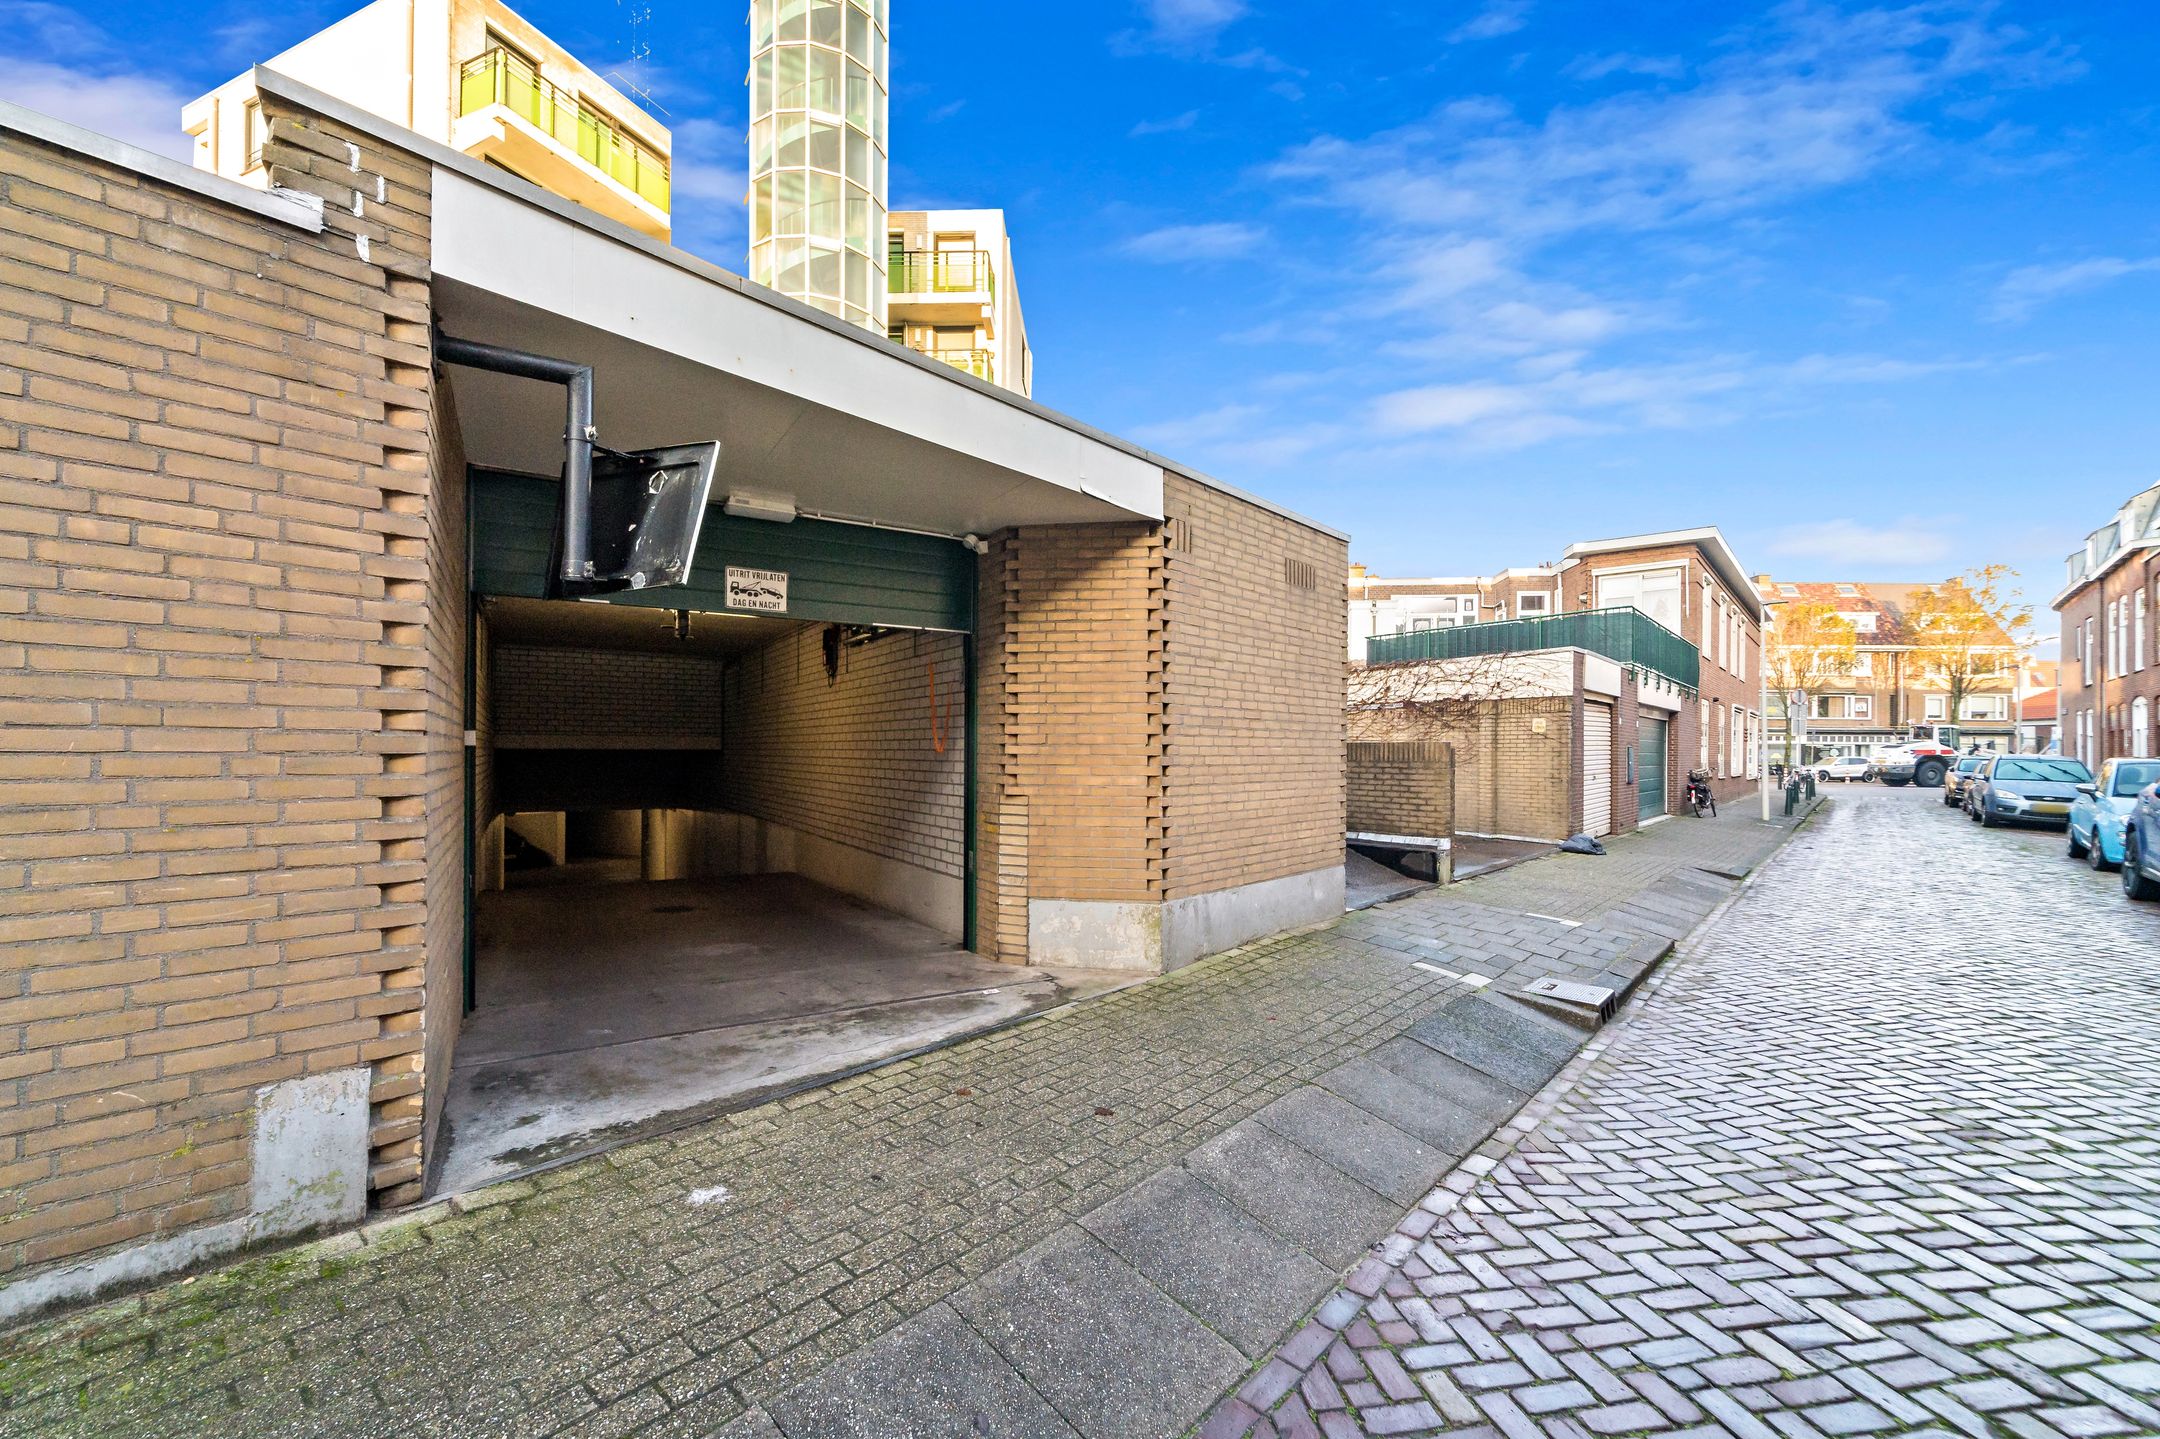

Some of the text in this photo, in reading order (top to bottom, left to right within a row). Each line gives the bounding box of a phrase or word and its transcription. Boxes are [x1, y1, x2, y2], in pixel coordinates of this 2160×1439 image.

[728, 569, 785, 582] UITRIT VRIJLATEN
[733, 598, 746, 606] DAG
[759, 601, 780, 609] NACHT
